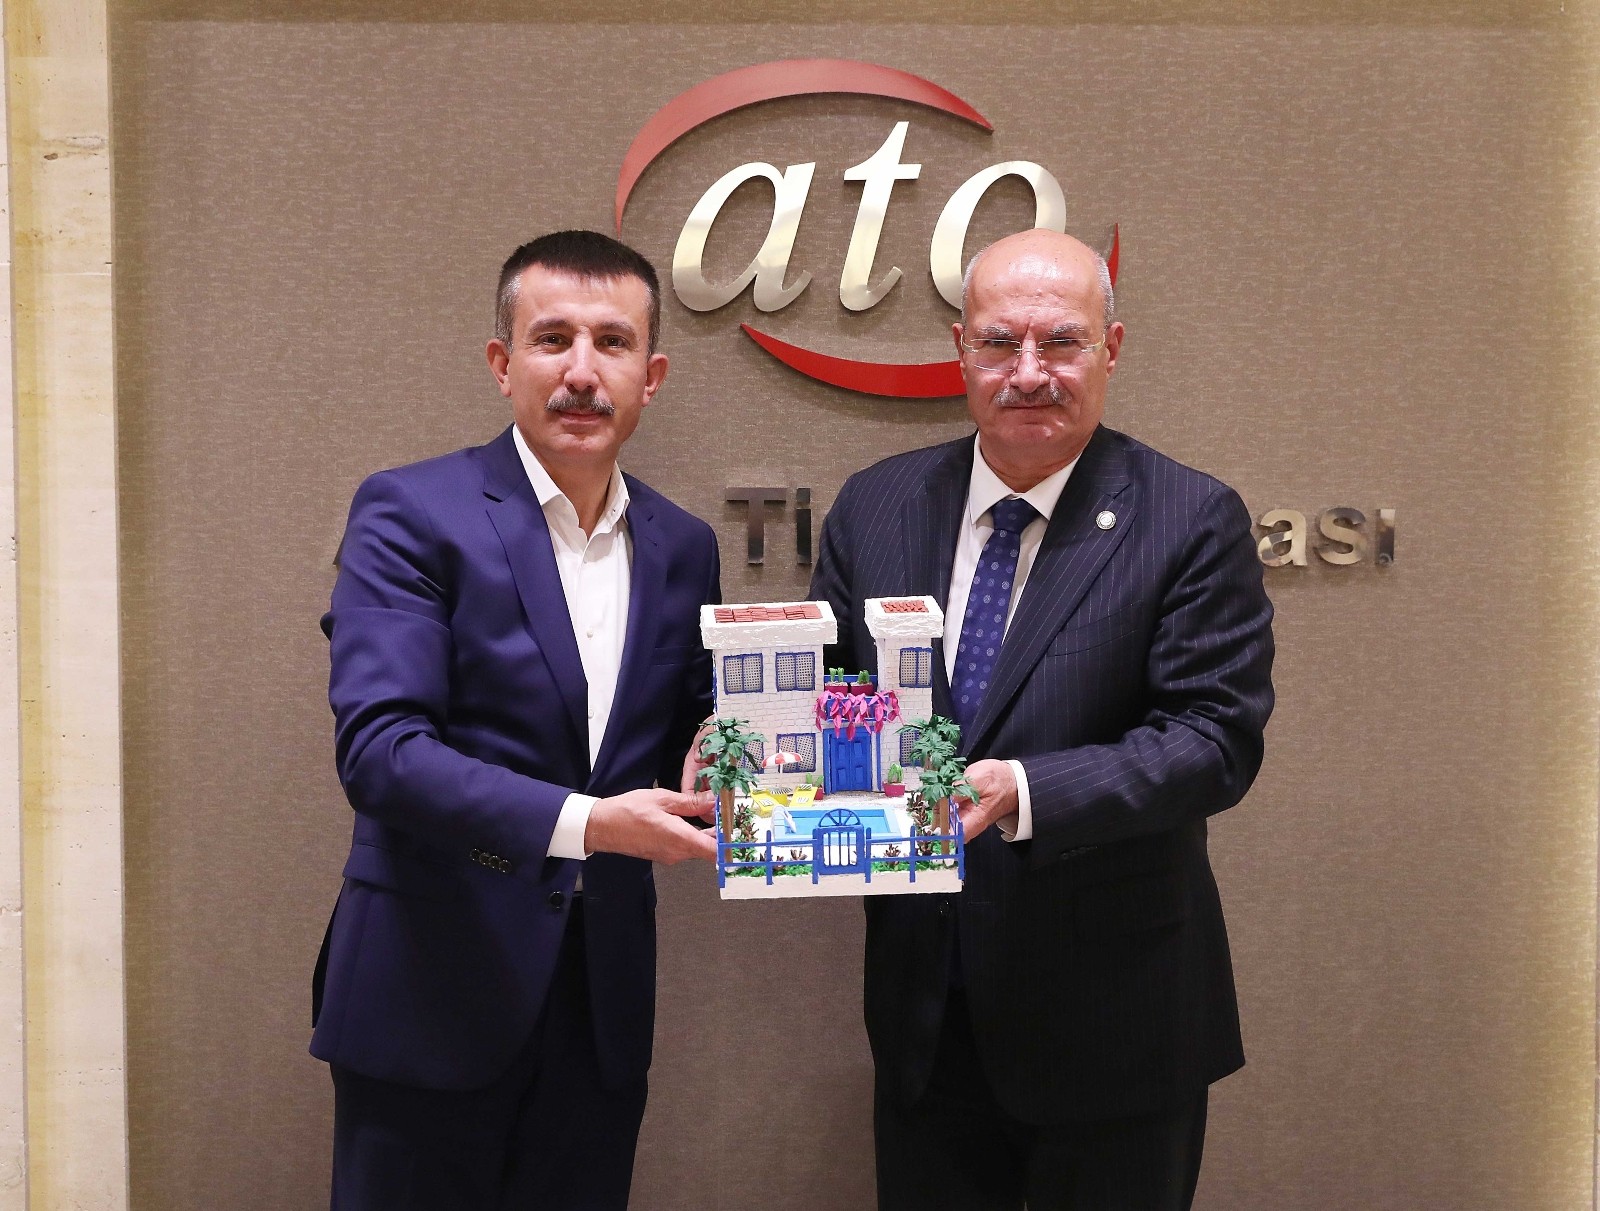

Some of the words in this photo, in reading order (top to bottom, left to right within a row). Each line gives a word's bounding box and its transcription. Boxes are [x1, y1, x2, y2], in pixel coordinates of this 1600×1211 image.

[672, 121, 1067, 312] ato
[725, 487, 812, 564] Ti
[1257, 507, 1396, 567] ası
